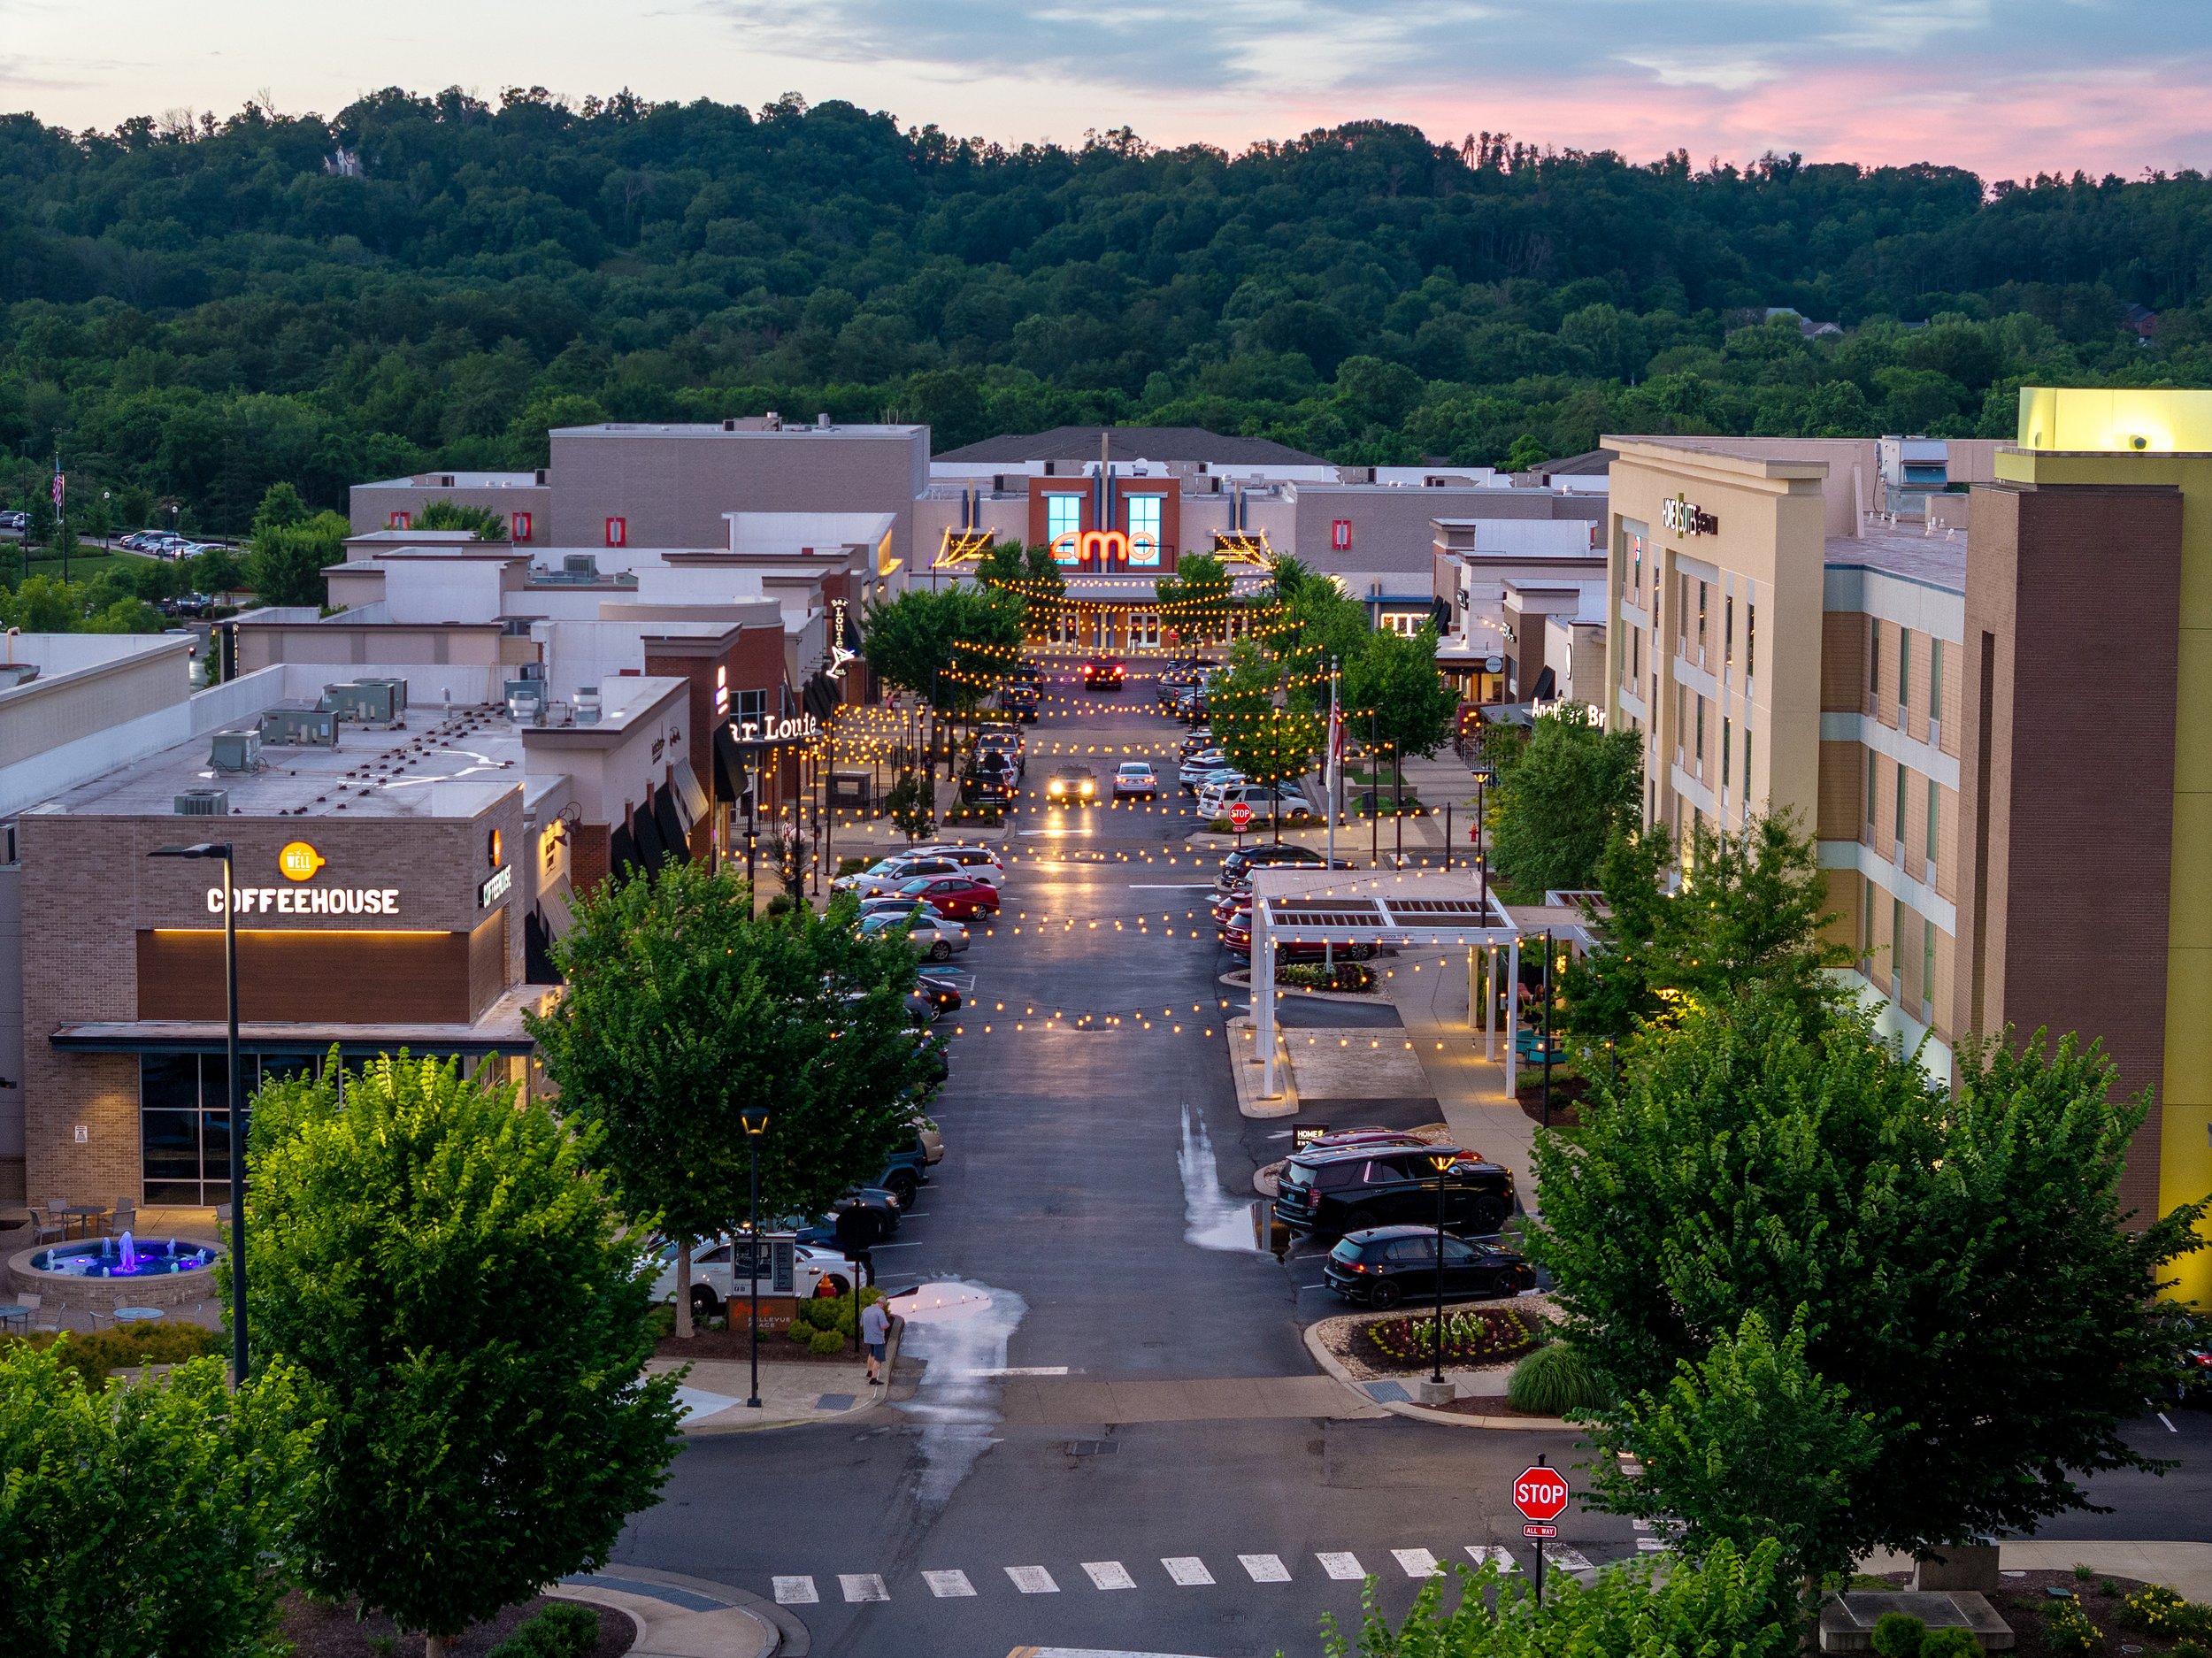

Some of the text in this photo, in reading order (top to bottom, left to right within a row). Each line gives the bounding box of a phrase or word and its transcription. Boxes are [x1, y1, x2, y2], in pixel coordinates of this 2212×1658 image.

[831, 599, 849, 608] Bar
[835, 607, 844, 648] Louie
[1587, 704, 1606, 727] Br
[729, 712, 816, 741] ar Louie
[1231, 809, 1250, 818] STOP
[286, 856, 311, 869] WELL
[1517, 1483, 1564, 1504] STOP
